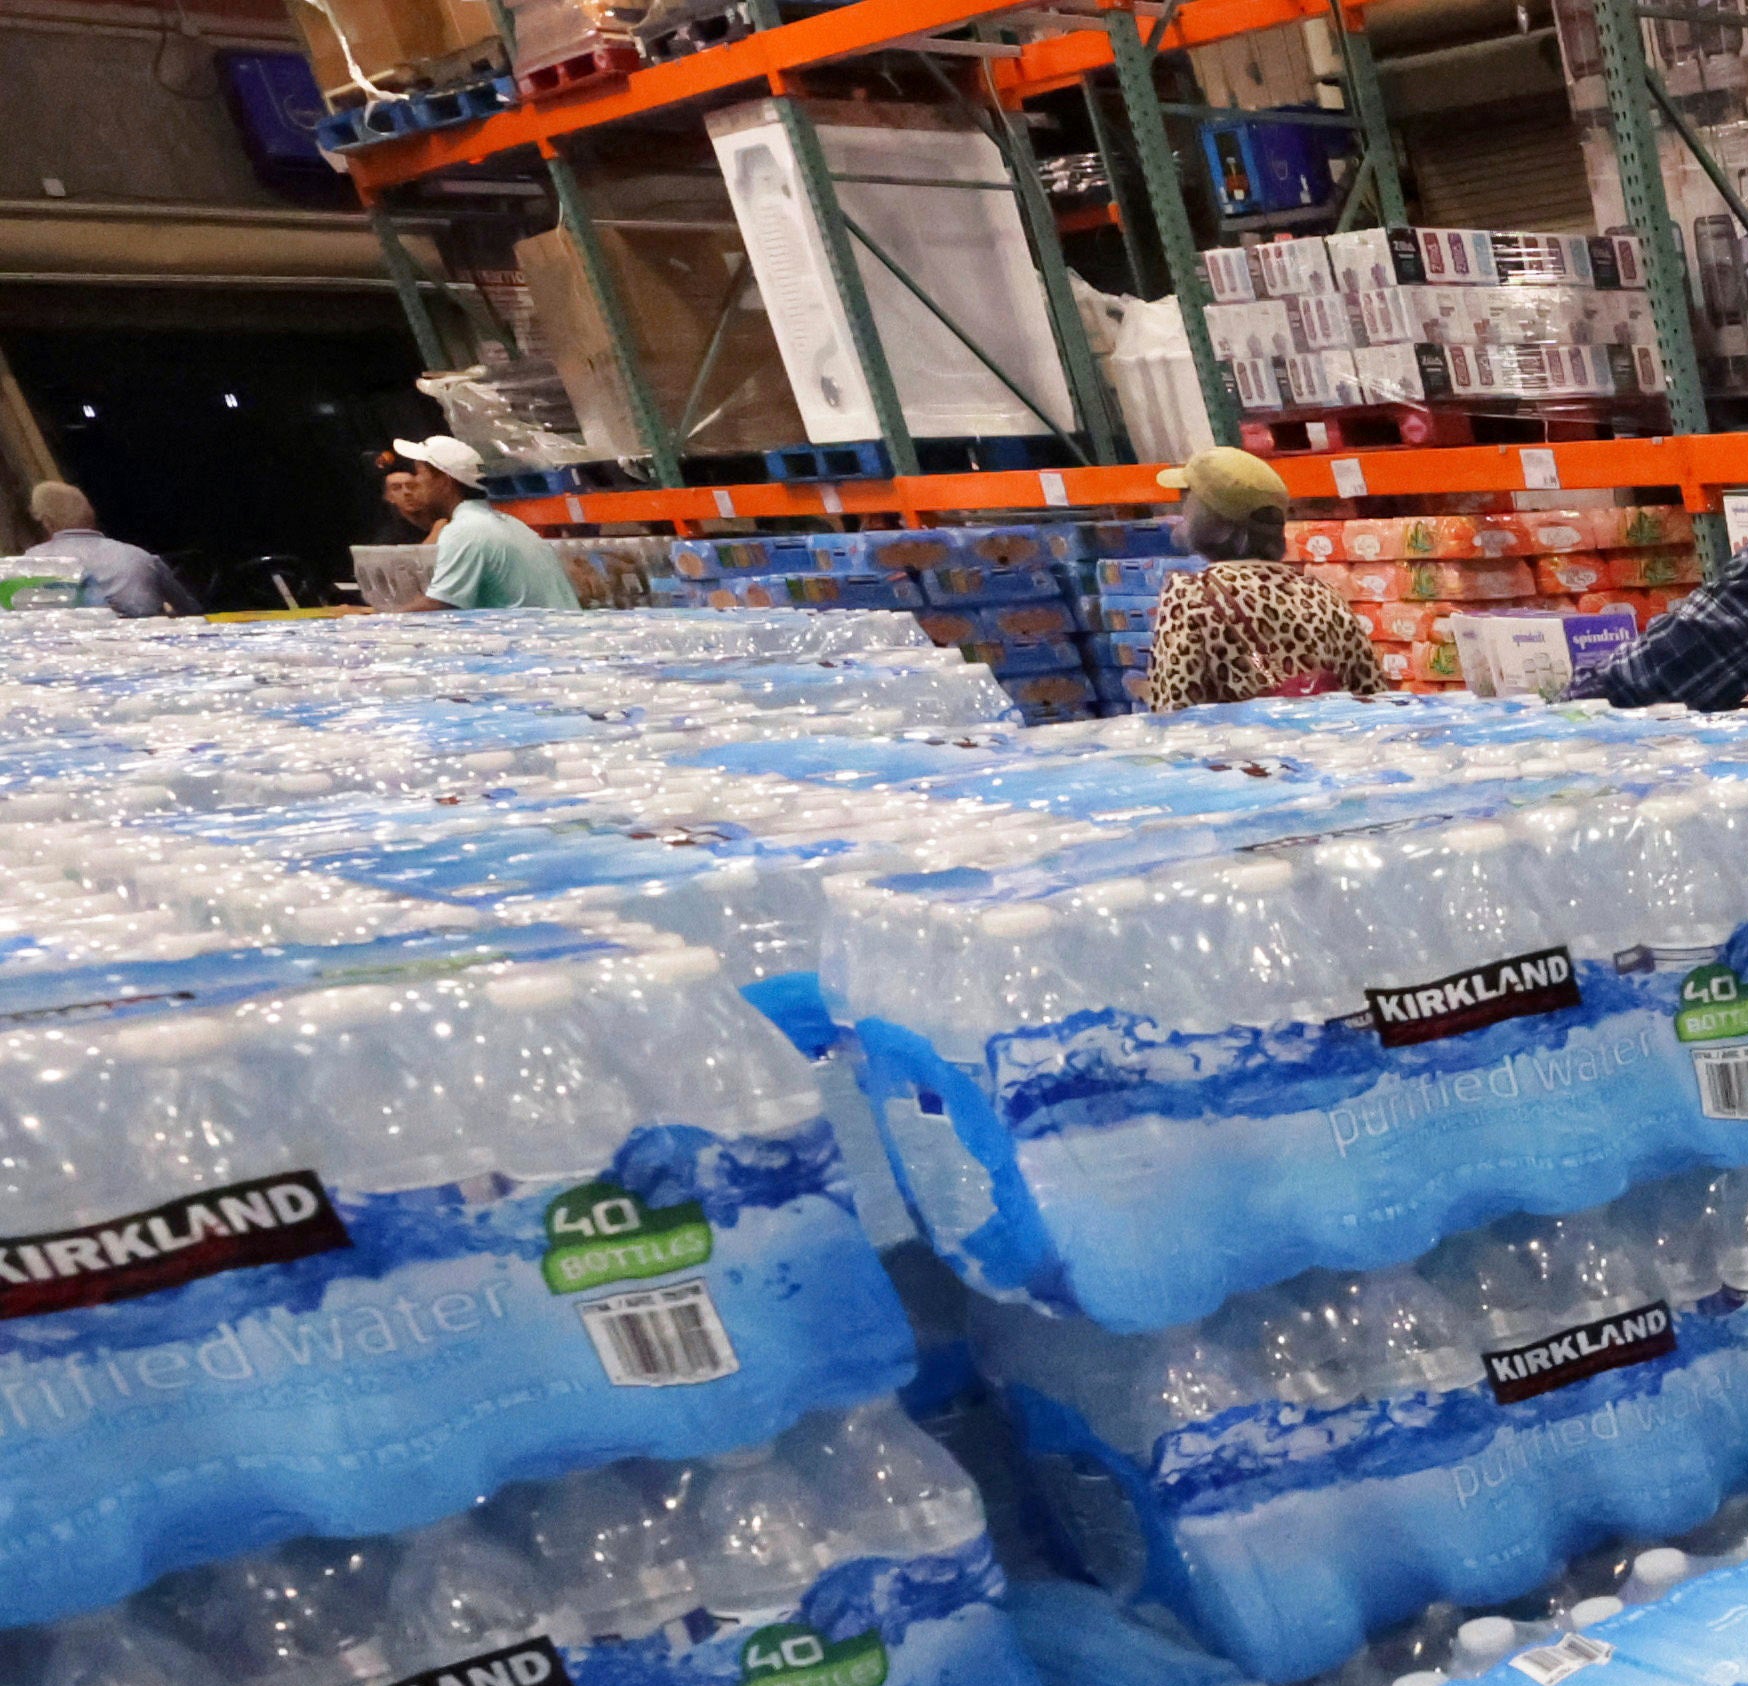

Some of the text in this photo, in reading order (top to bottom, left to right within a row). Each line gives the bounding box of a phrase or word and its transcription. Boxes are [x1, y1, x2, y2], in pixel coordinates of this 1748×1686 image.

[1512, 632, 1545, 646] spindrift
[1573, 627, 1630, 649] spindrift
[1375, 952, 1570, 1024] KIRKLAND
[1681, 975, 1738, 1006] 40
[1325, 1028, 1654, 1157] purified water
[551, 1198, 641, 1239] 40
[559, 1231, 708, 1282] BOTTLES
[277, 1277, 514, 1363] water
[1489, 1306, 1668, 1386] KIRKLAND
[1449, 1365, 1736, 1505] purified water
[743, 1635, 826, 1674] 40
